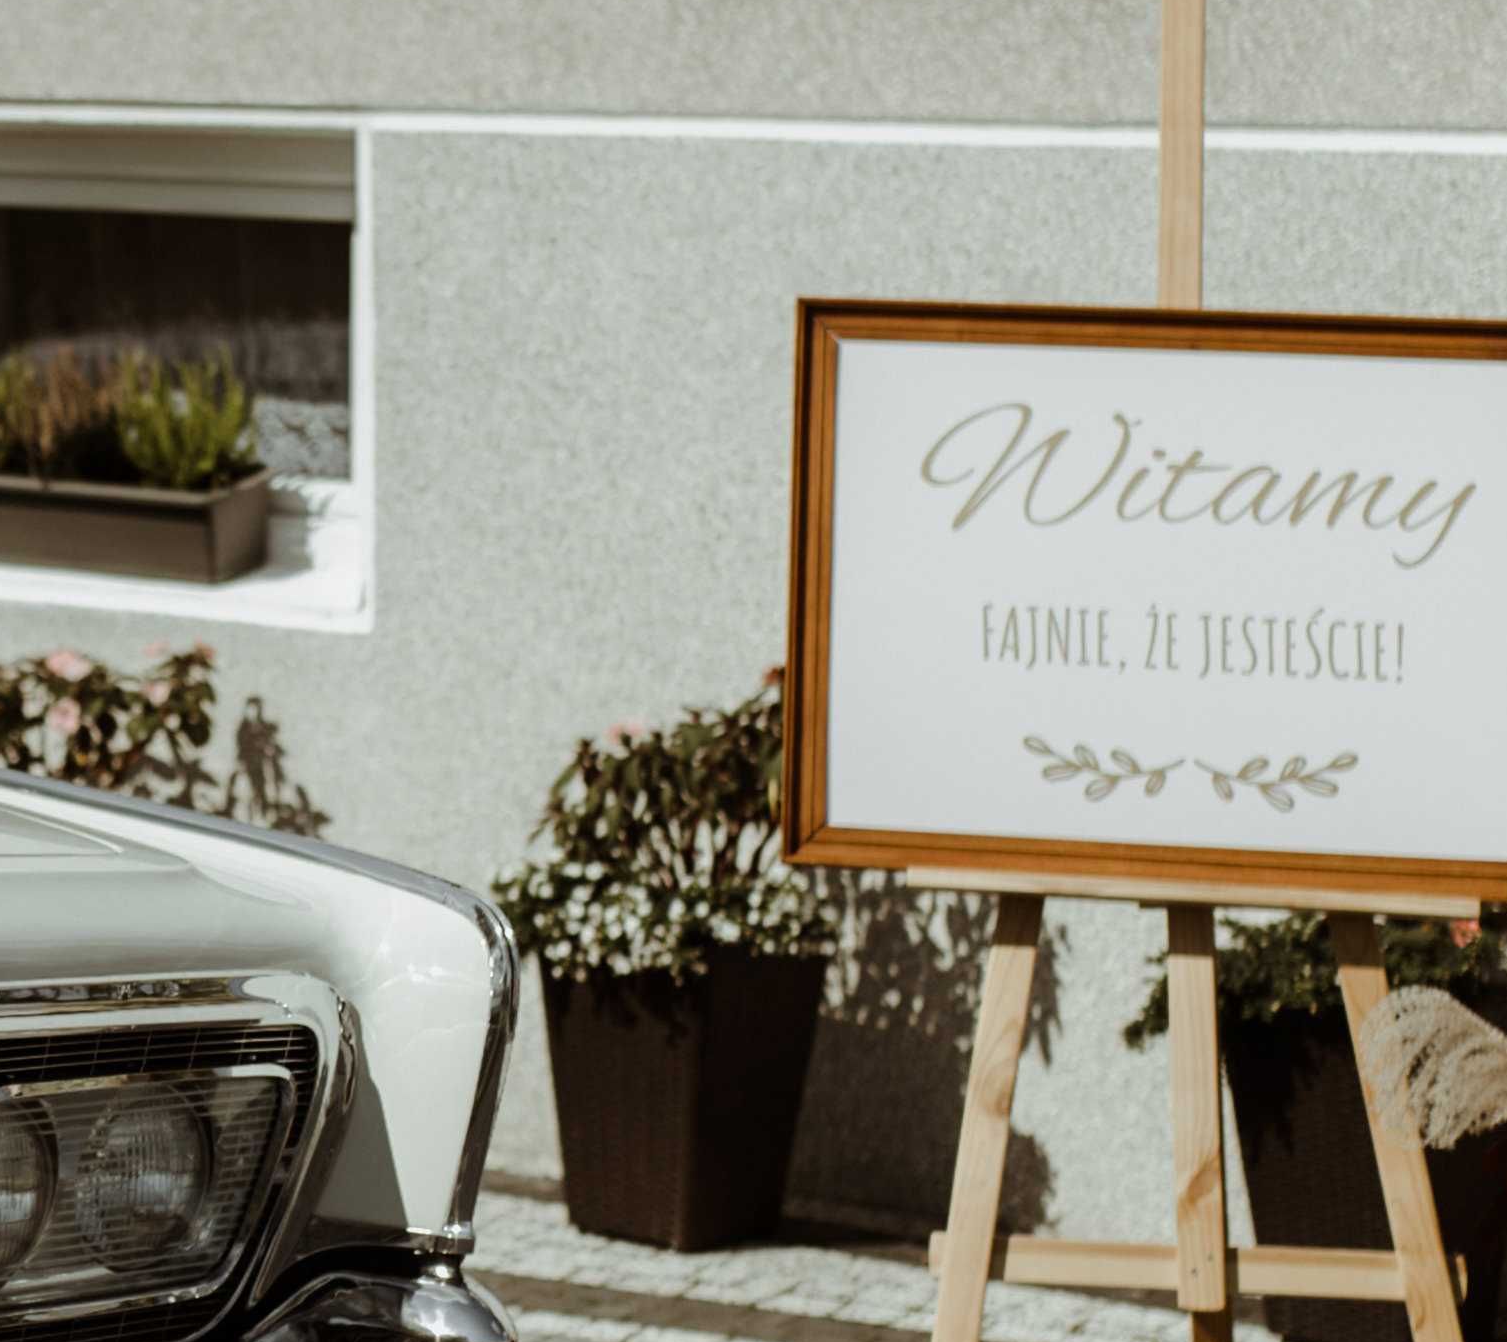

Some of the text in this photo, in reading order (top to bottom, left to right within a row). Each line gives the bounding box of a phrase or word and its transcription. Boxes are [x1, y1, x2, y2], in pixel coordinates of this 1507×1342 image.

[920, 402, 1476, 569] Witamy
[979, 602, 1406, 686] FAJNIE, ŻE JESTEŚCIE!
